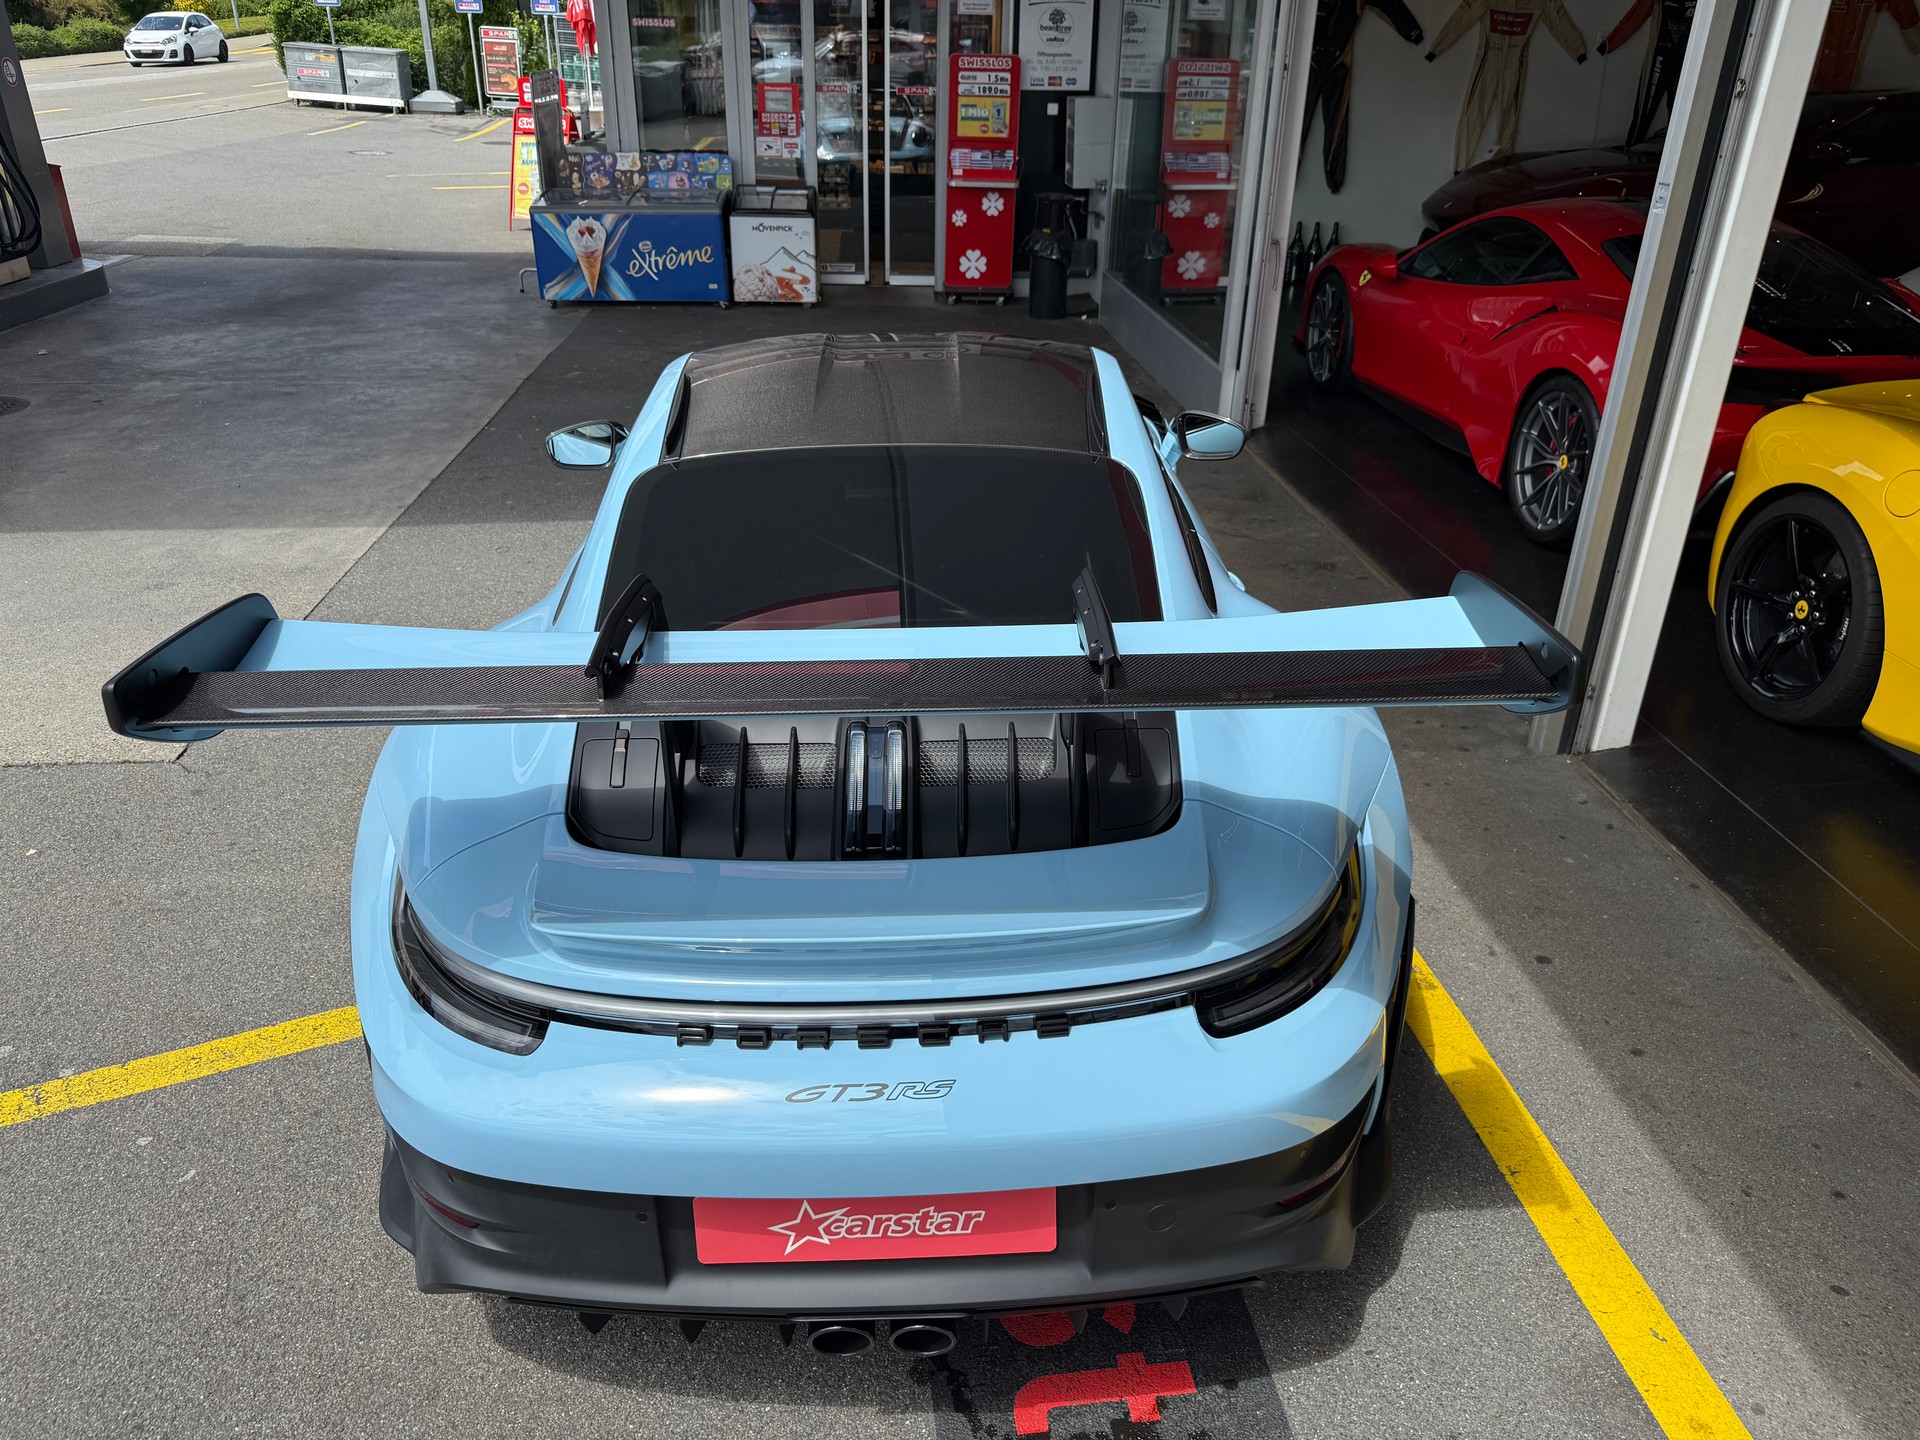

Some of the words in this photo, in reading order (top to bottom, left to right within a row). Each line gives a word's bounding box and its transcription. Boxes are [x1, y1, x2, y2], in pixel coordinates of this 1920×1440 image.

[632, 17, 676, 28] SWISSLOS
[959, 57, 1012, 69] SWISSLOS
[826, 1206, 986, 1239] carstar
